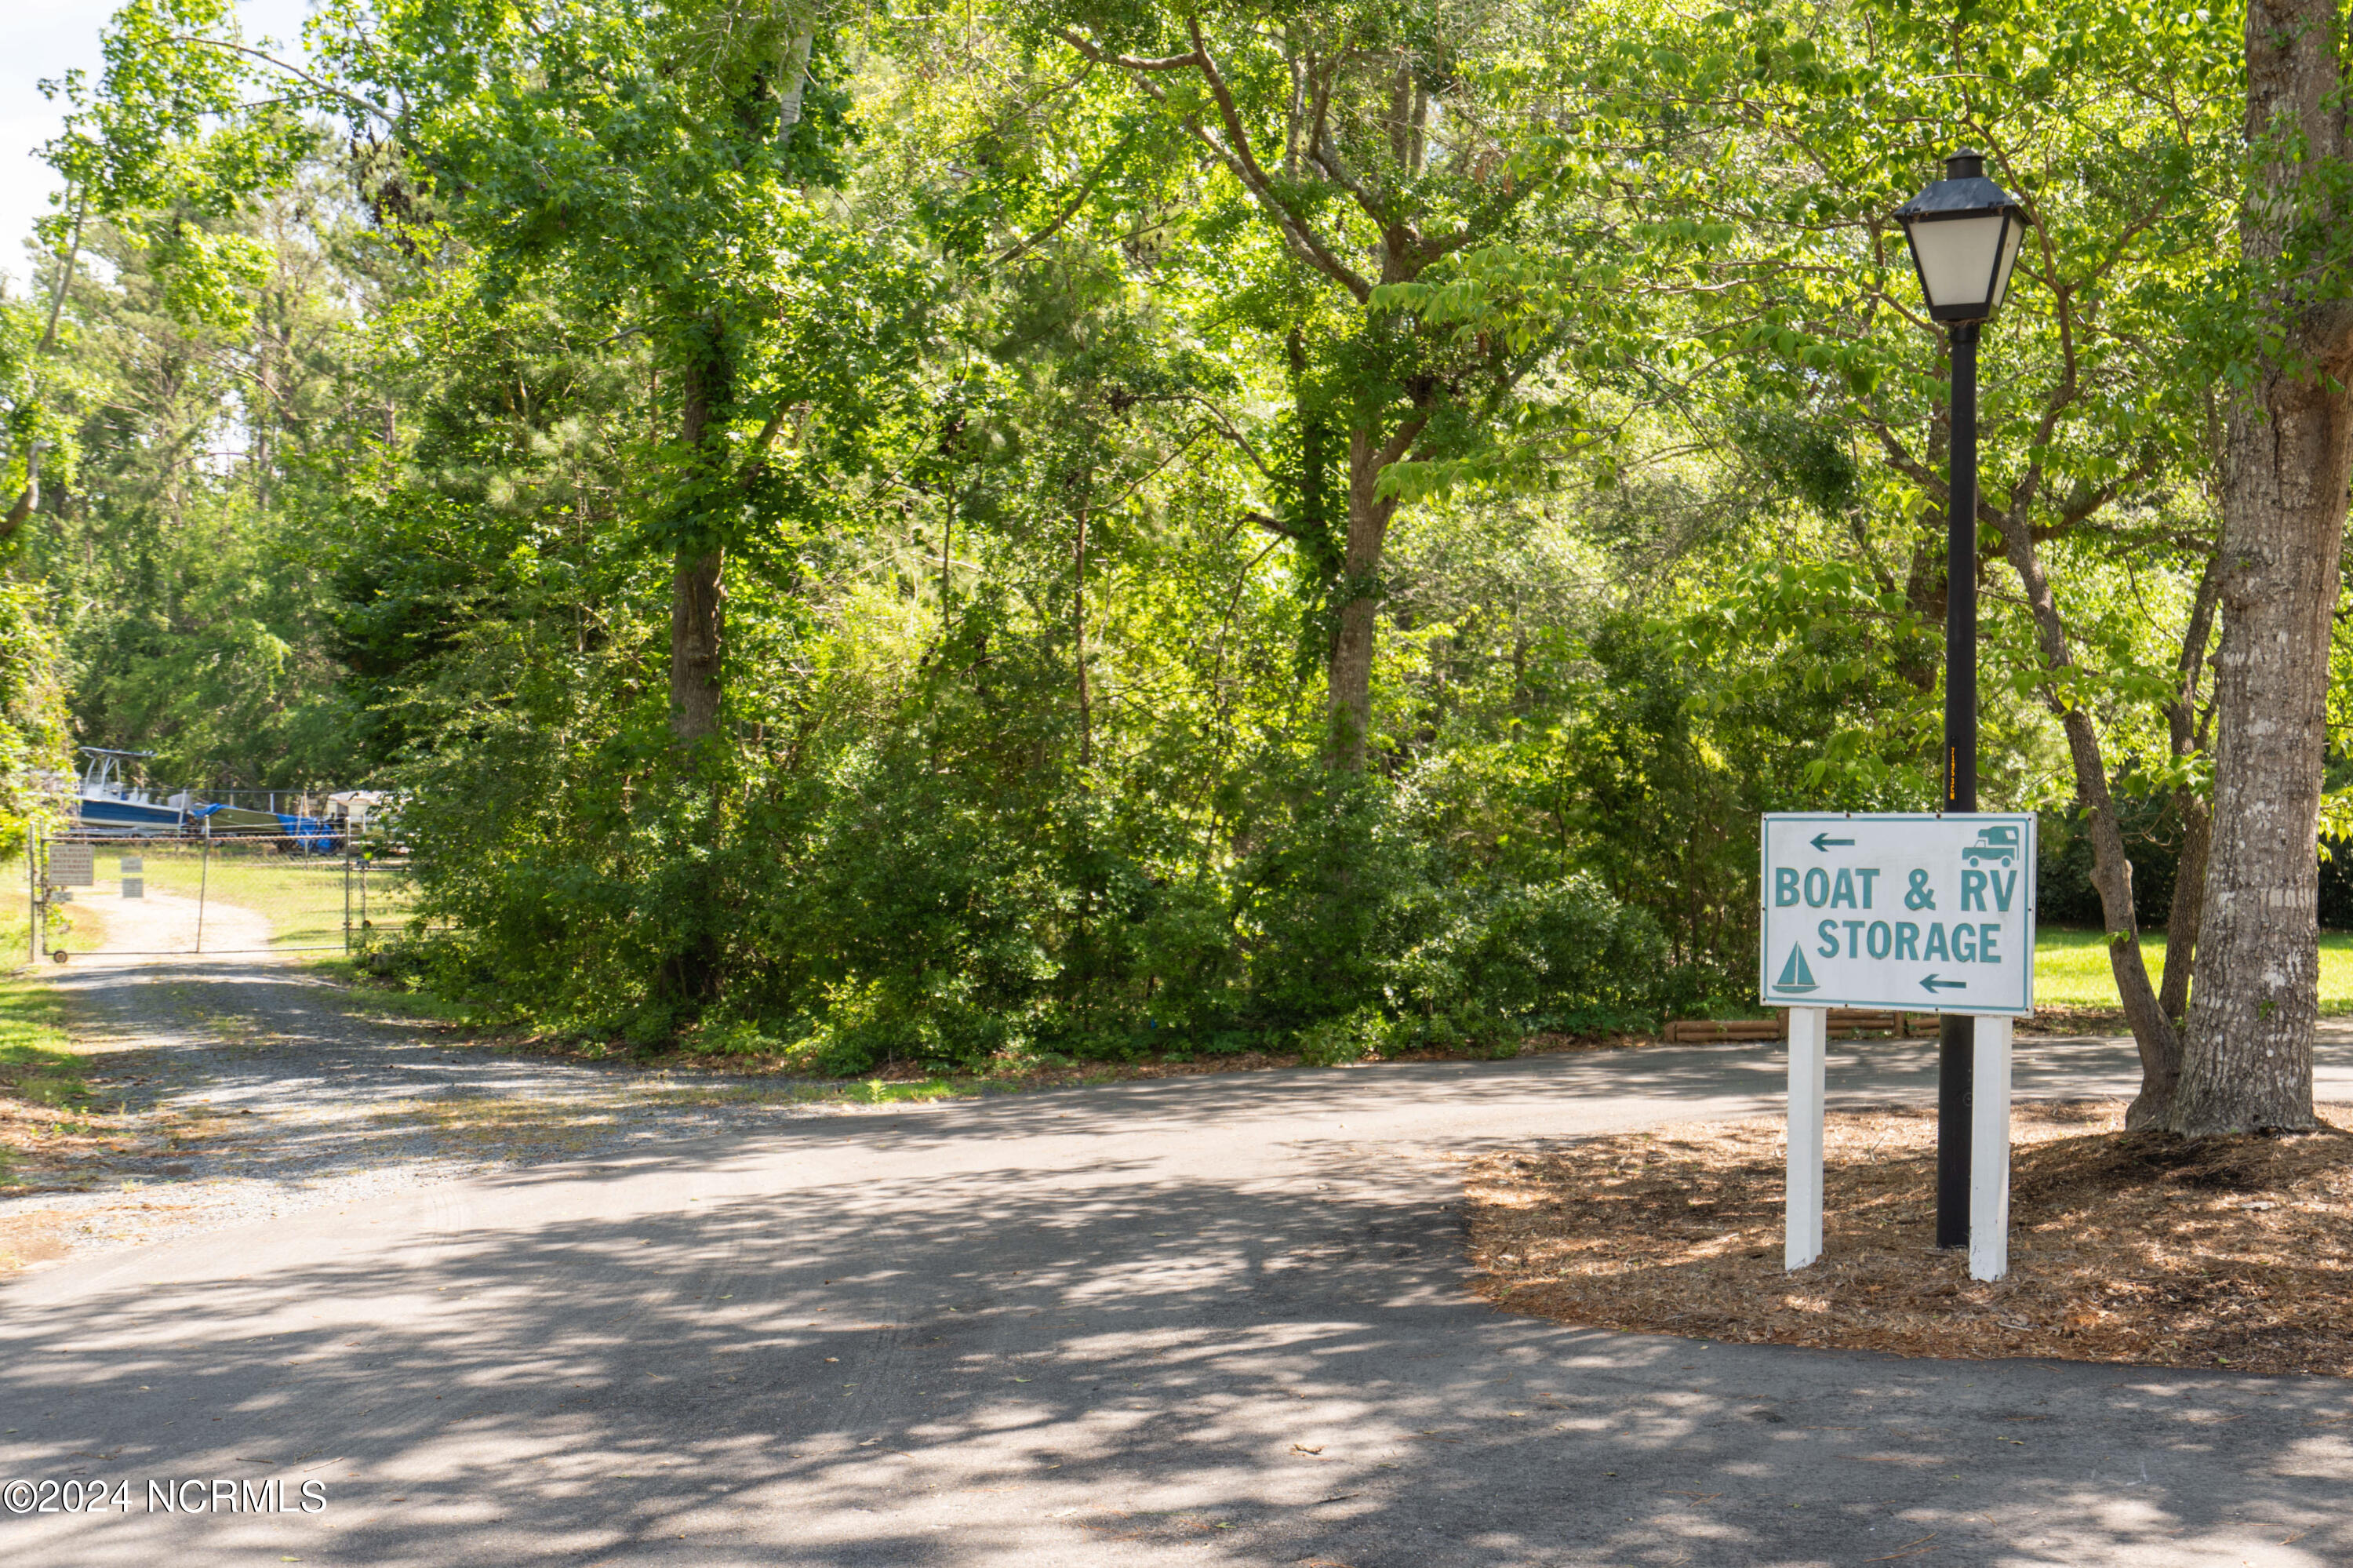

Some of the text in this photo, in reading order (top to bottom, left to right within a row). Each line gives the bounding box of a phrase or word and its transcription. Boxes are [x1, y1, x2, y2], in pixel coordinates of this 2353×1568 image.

[1775, 867, 2018, 912] BOAT & RV
[1817, 919, 2002, 964] STORAGE
